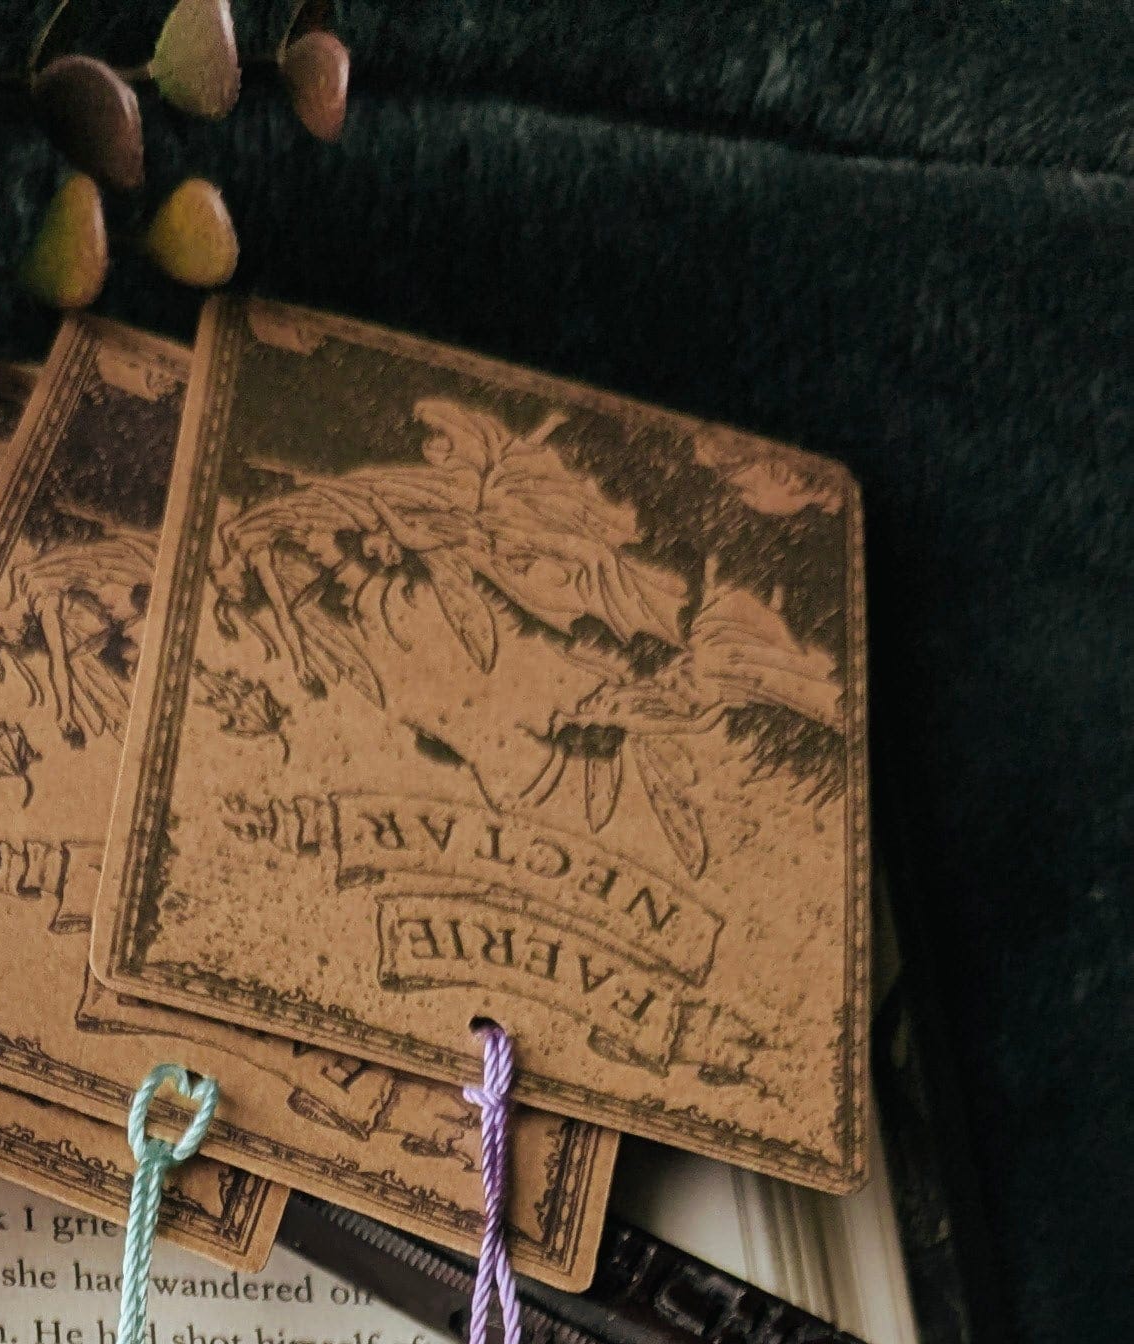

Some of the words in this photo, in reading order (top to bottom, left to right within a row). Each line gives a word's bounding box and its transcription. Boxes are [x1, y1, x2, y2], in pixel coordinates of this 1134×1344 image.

[357, 808, 682, 934] NECTAR
[396, 917, 657, 1024] FAERIE
[2, 1257, 56, 1289] she
[150, 1271, 314, 1303] wandered
